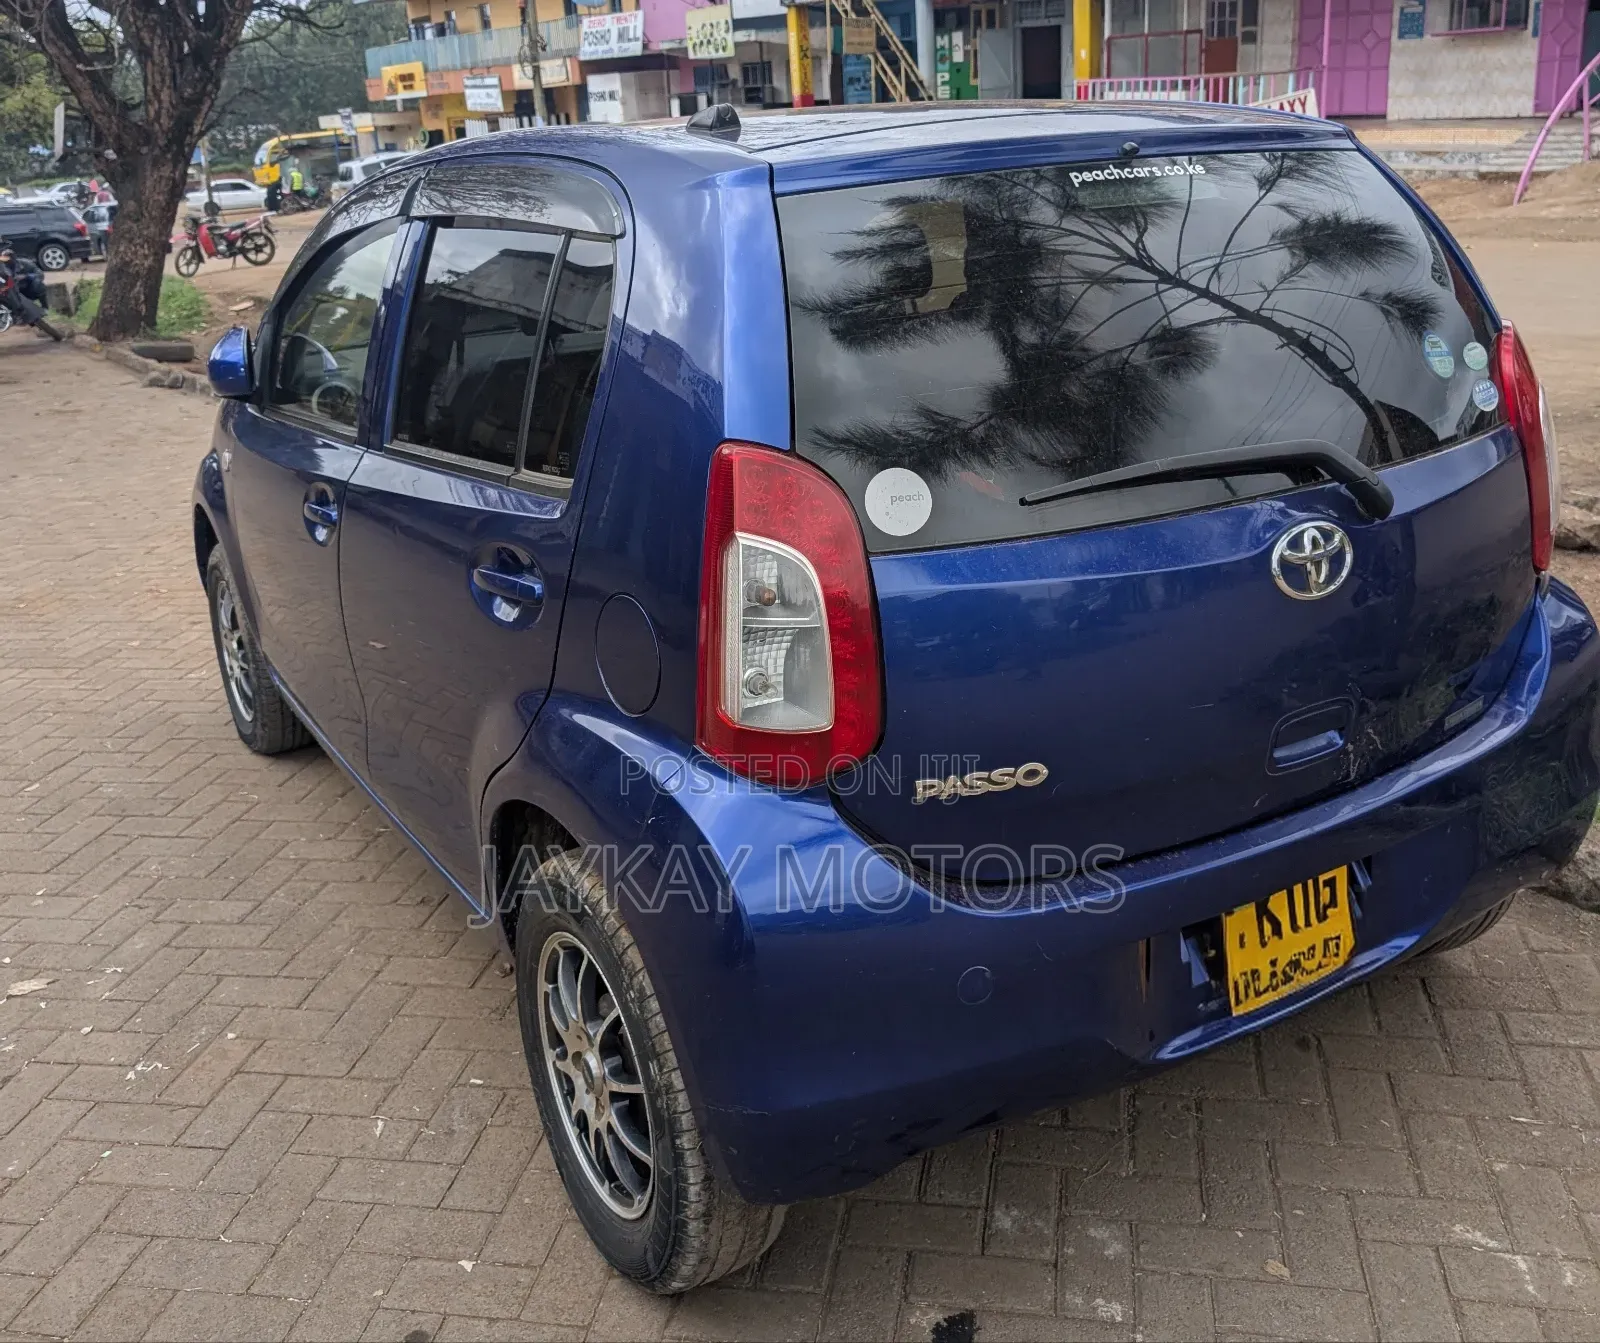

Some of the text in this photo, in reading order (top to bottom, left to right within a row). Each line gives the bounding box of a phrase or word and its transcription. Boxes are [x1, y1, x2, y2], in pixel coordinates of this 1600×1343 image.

[583, 25, 640, 46] POSHO MILL
[1069, 162, 1206, 187] peachcars.co.ke
[890, 491, 925, 505] peach
[915, 762, 1049, 804] PASSO
